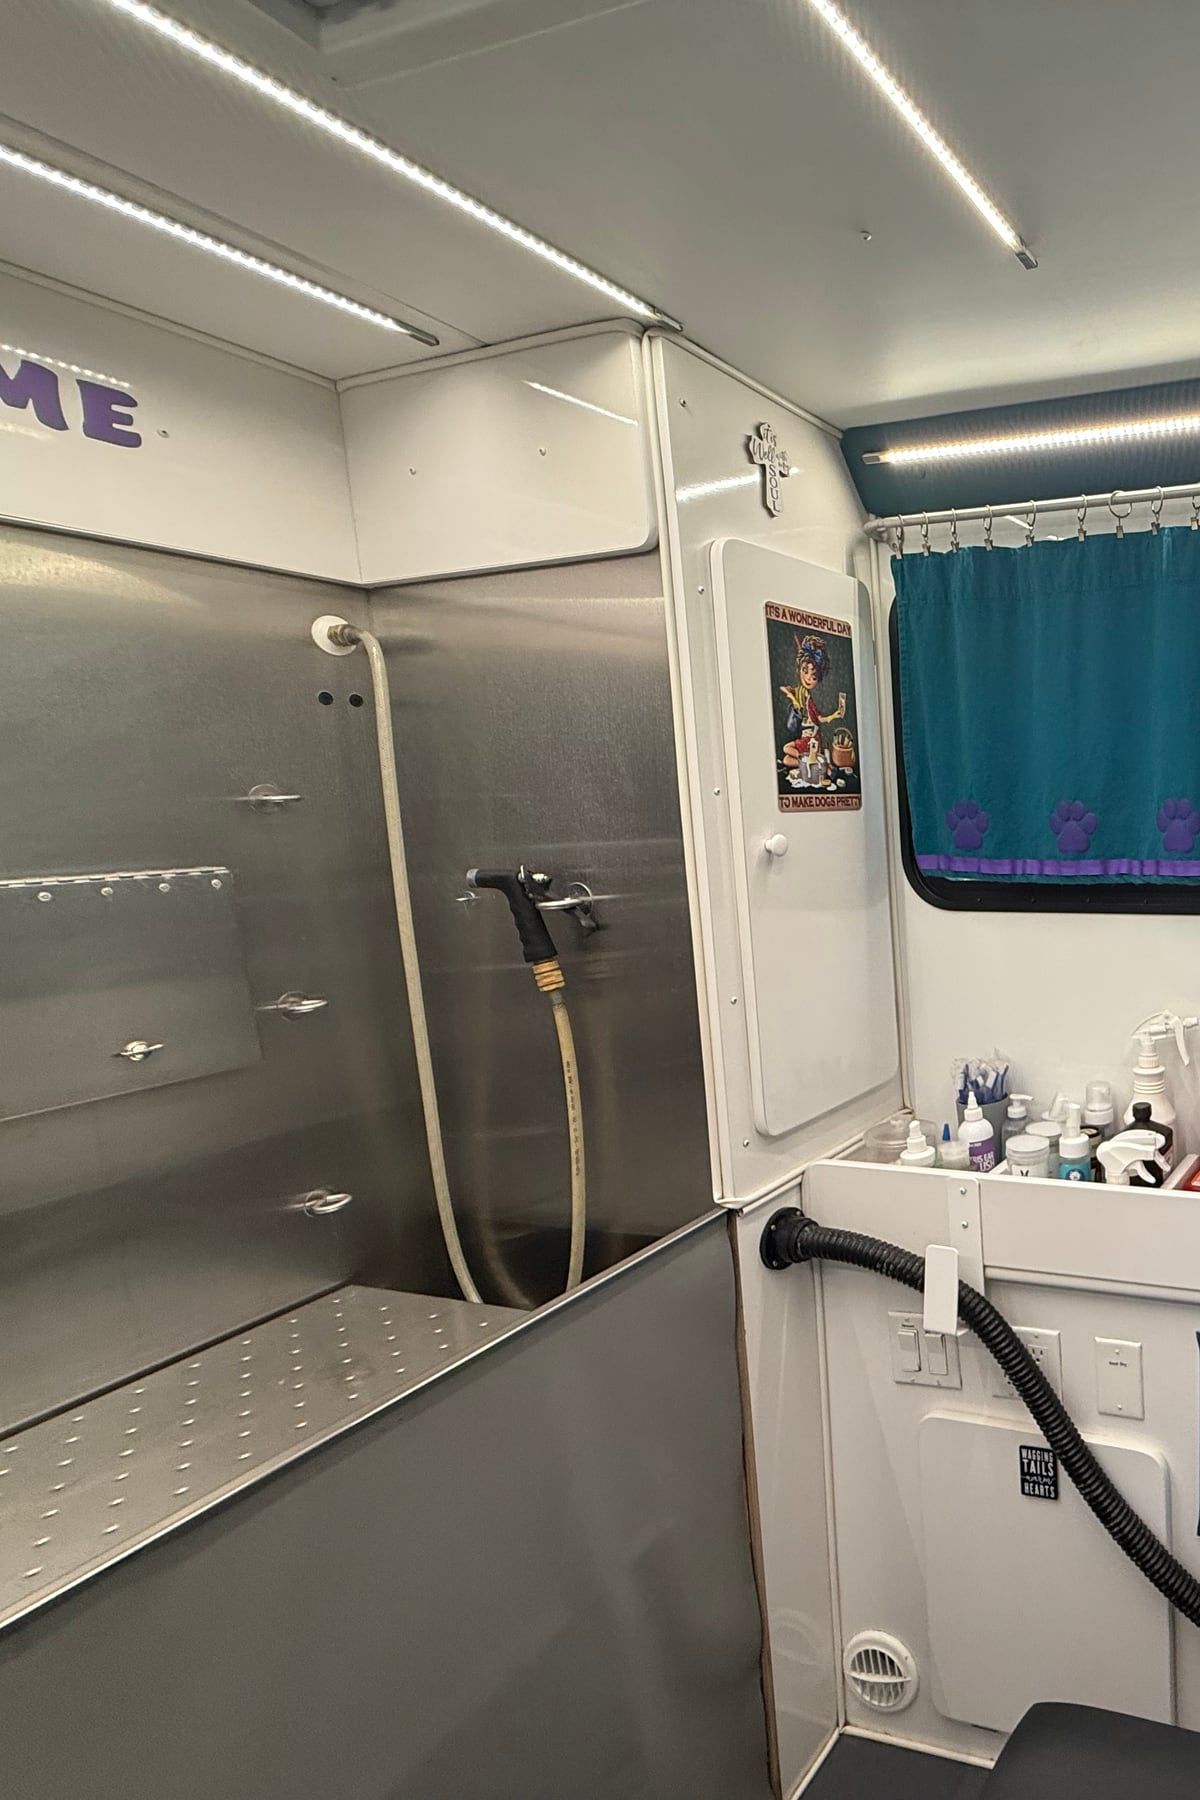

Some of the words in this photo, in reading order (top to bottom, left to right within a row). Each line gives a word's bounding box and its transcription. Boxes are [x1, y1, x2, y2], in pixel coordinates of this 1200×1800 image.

[752, 437, 776, 464] Well
[768, 464, 781, 512] SOUL
[781, 608, 788, 620] A
[788, 610, 836, 632] WONDERFUL
[837, 622, 851, 635] DAY
[779, 797, 790, 808] TO
[791, 796, 814, 808] MAKE
[815, 796, 835, 807] DOGS
[1022, 1459, 1054, 1477] TAILS
[1024, 1482, 1056, 1498] HEARTS
